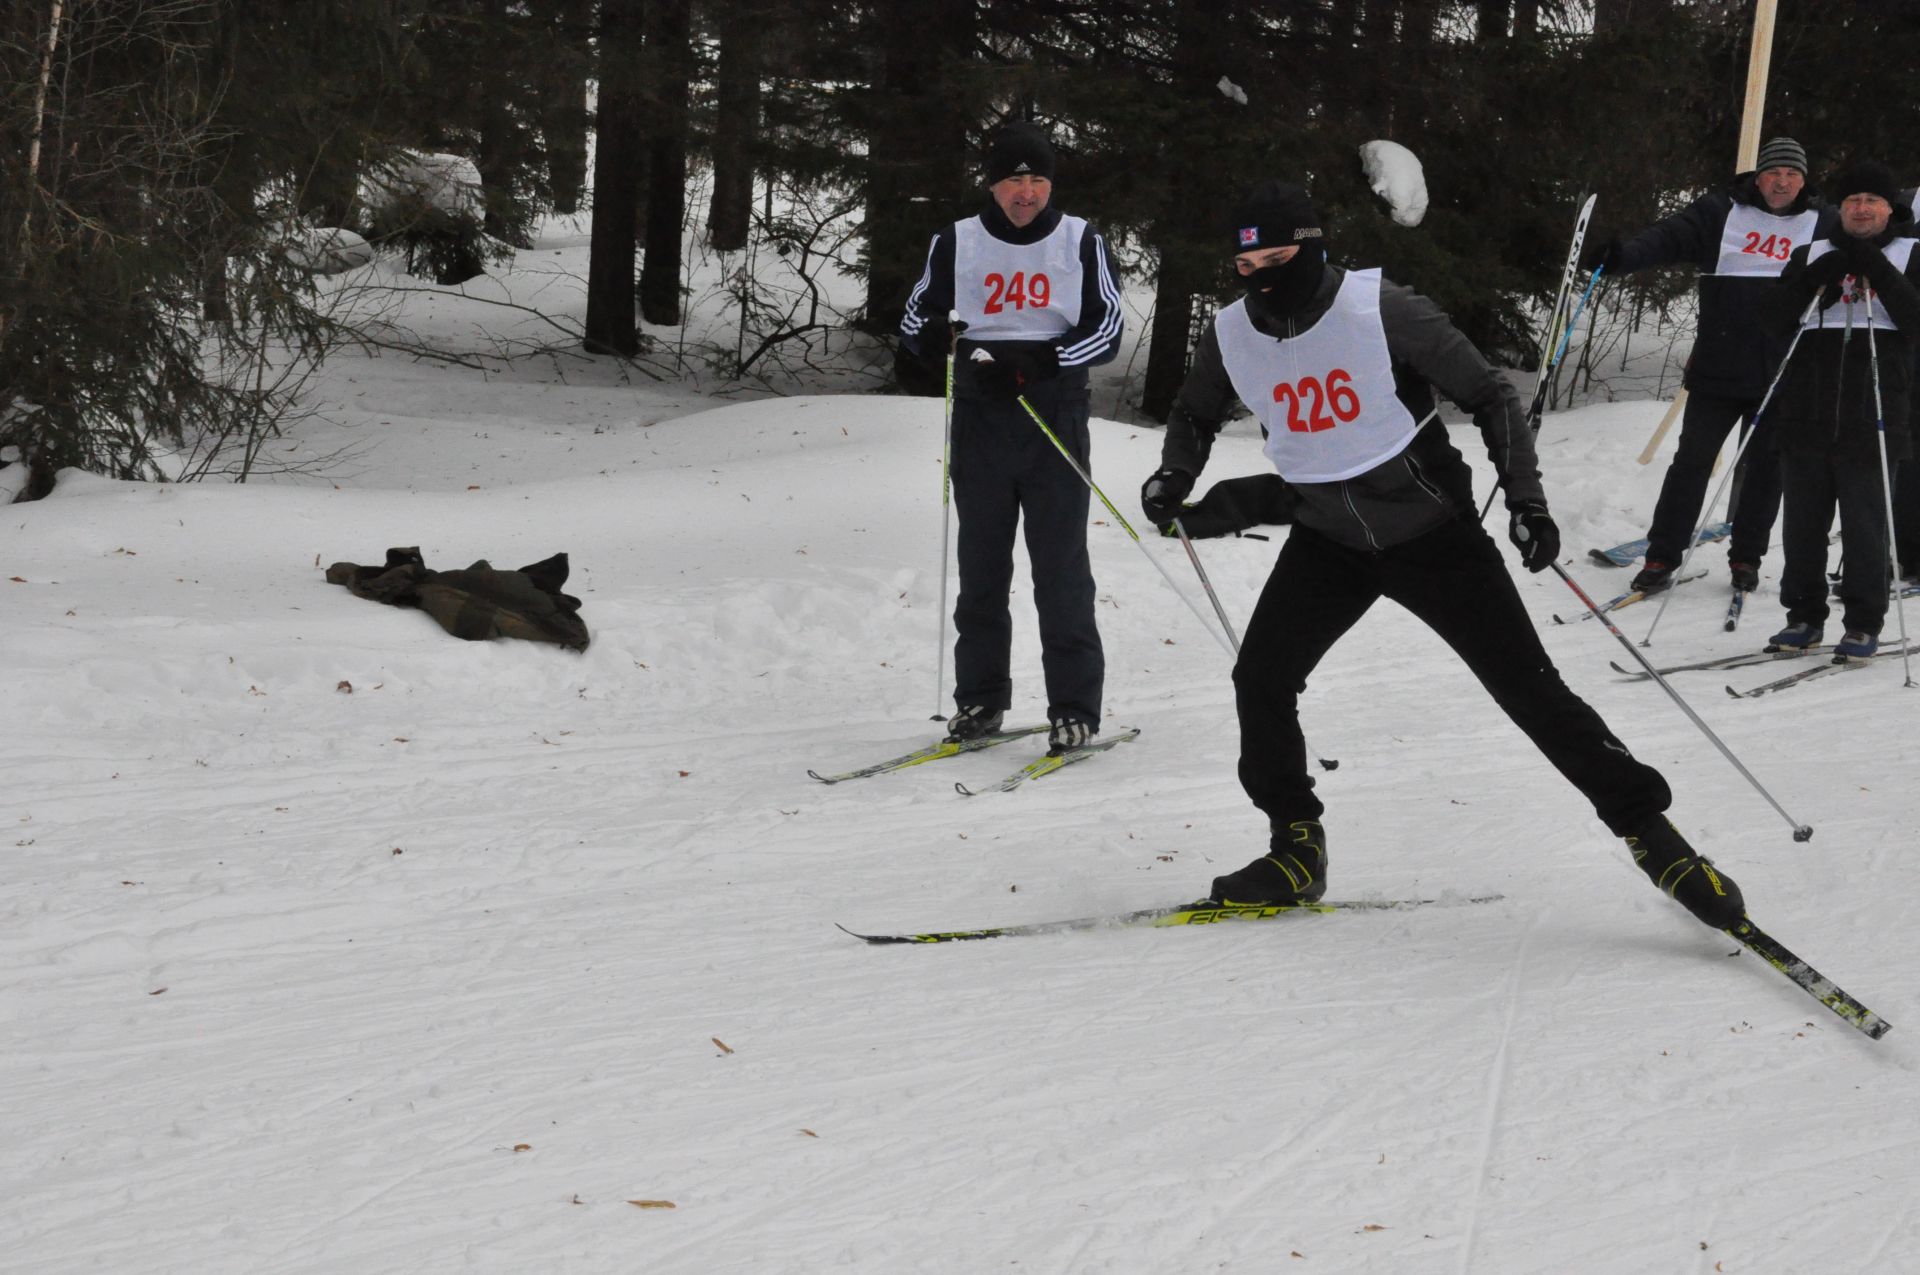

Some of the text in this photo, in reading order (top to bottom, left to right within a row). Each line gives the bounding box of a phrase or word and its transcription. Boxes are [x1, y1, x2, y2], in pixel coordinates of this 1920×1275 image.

[1742, 231, 1793, 261] 243
[984, 272, 1050, 315] 249
[1273, 368, 1361, 433] 226
